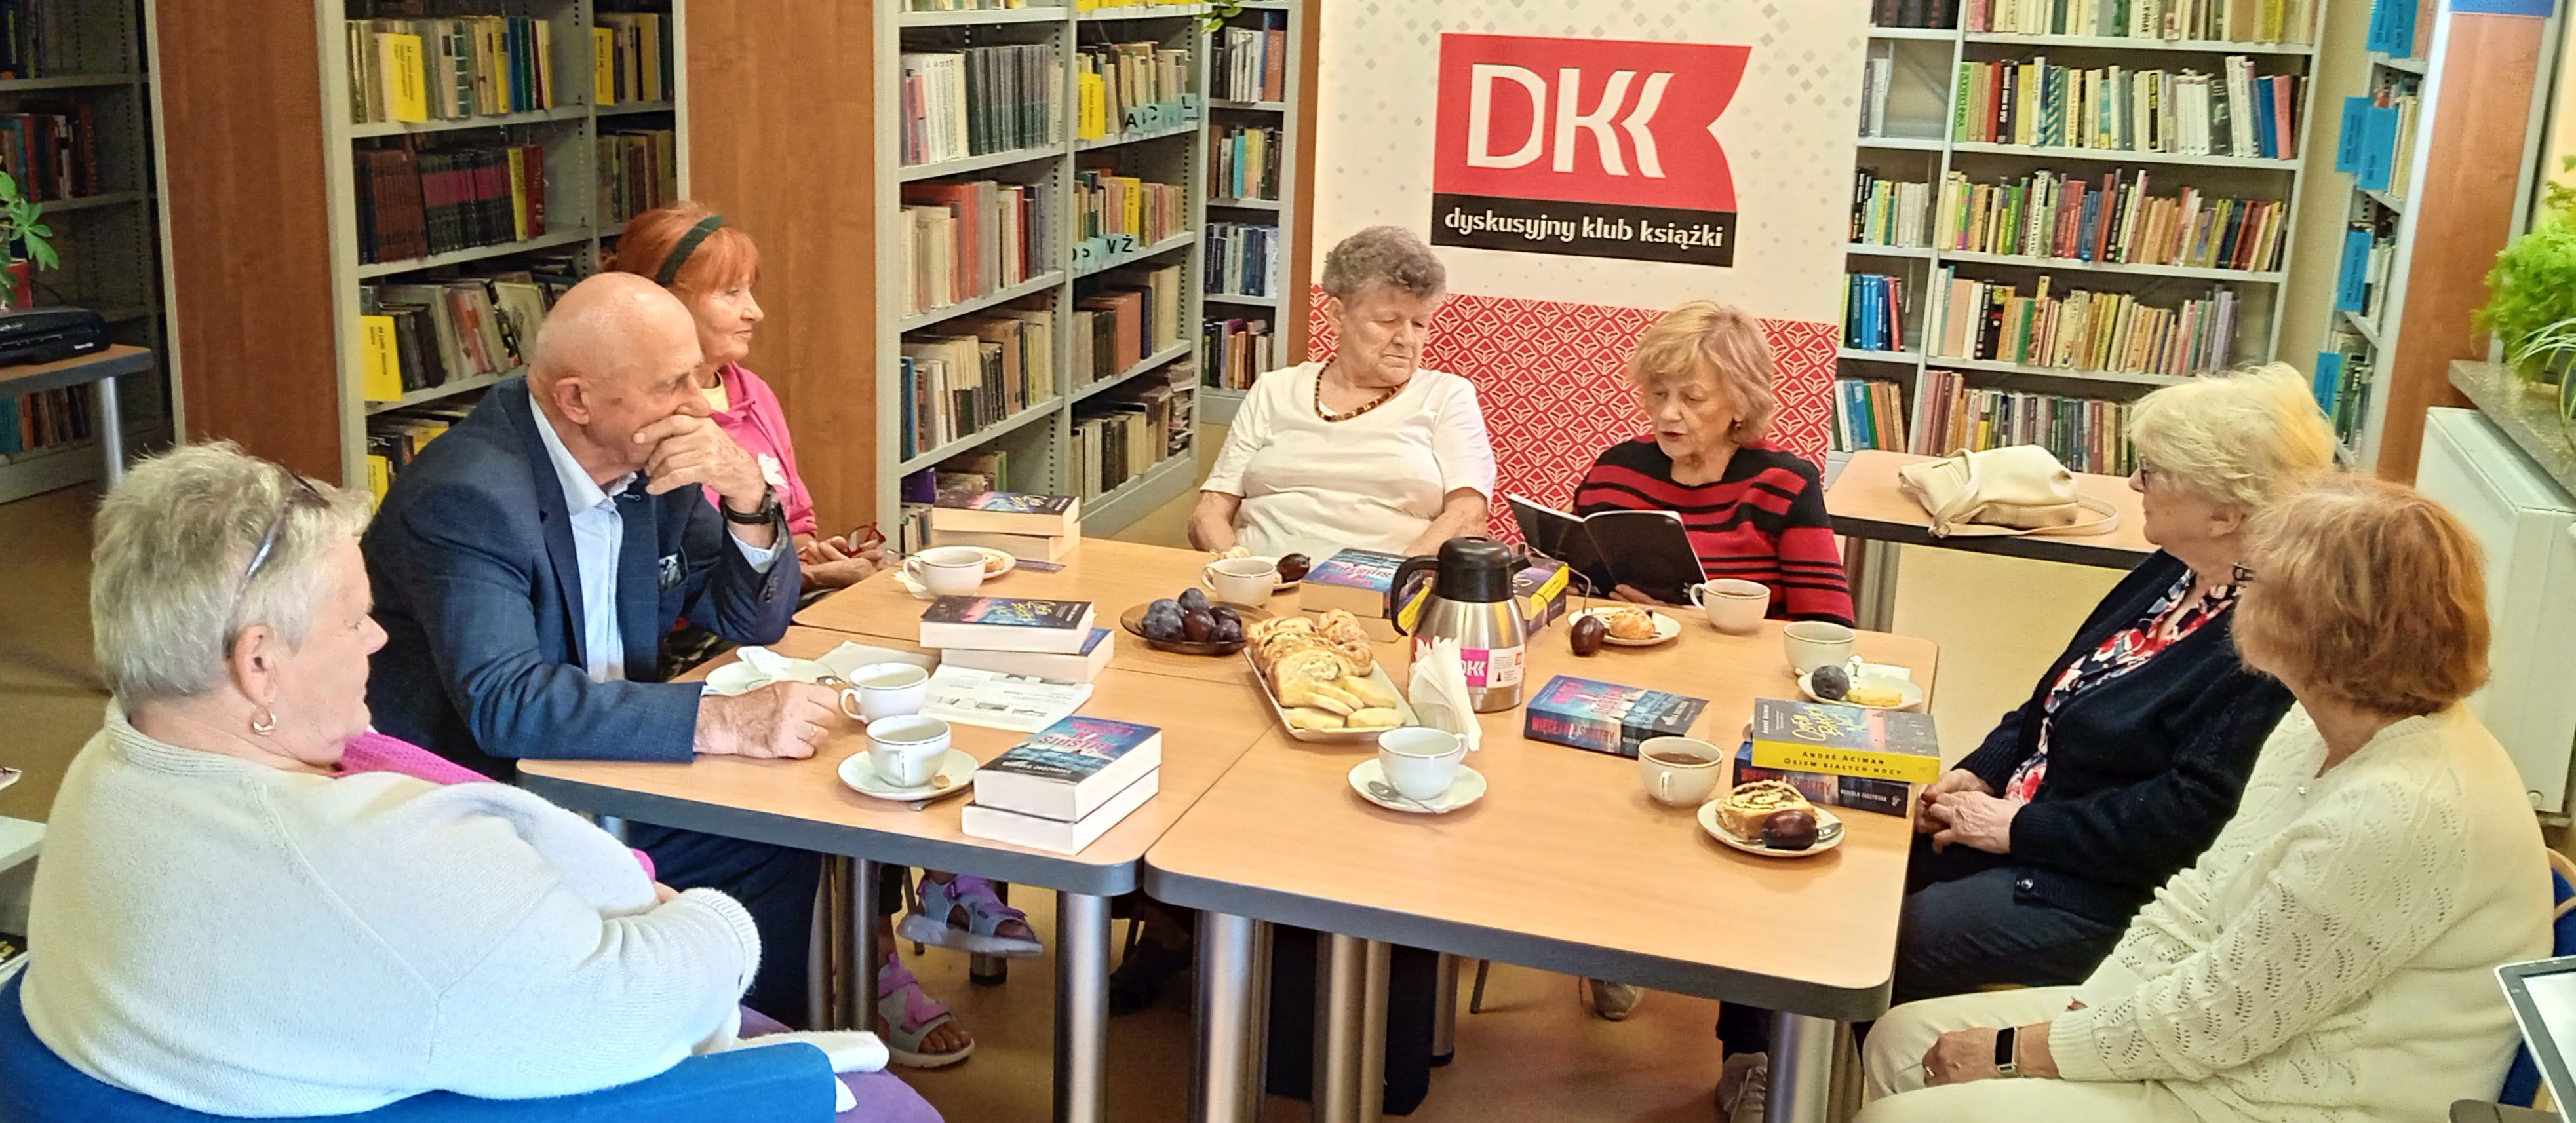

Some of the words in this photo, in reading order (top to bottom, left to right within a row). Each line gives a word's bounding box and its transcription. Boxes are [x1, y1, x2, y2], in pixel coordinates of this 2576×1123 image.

[1125, 113, 1138, 128] A
[1444, 207, 1576, 242] dyskusyjny
[1582, 216, 1633, 240] klub
[1640, 220, 1724, 249] książki
[1122, 235, 1133, 252] Ż
[1784, 758, 1817, 767] OSIEM
[1824, 763, 1867, 772] BIAŁYCH
[1802, 751, 1837, 761] ANDRÉ
[1842, 755, 1884, 765] ACIMAN
[1793, 777, 1831, 796] SIOSTRY
